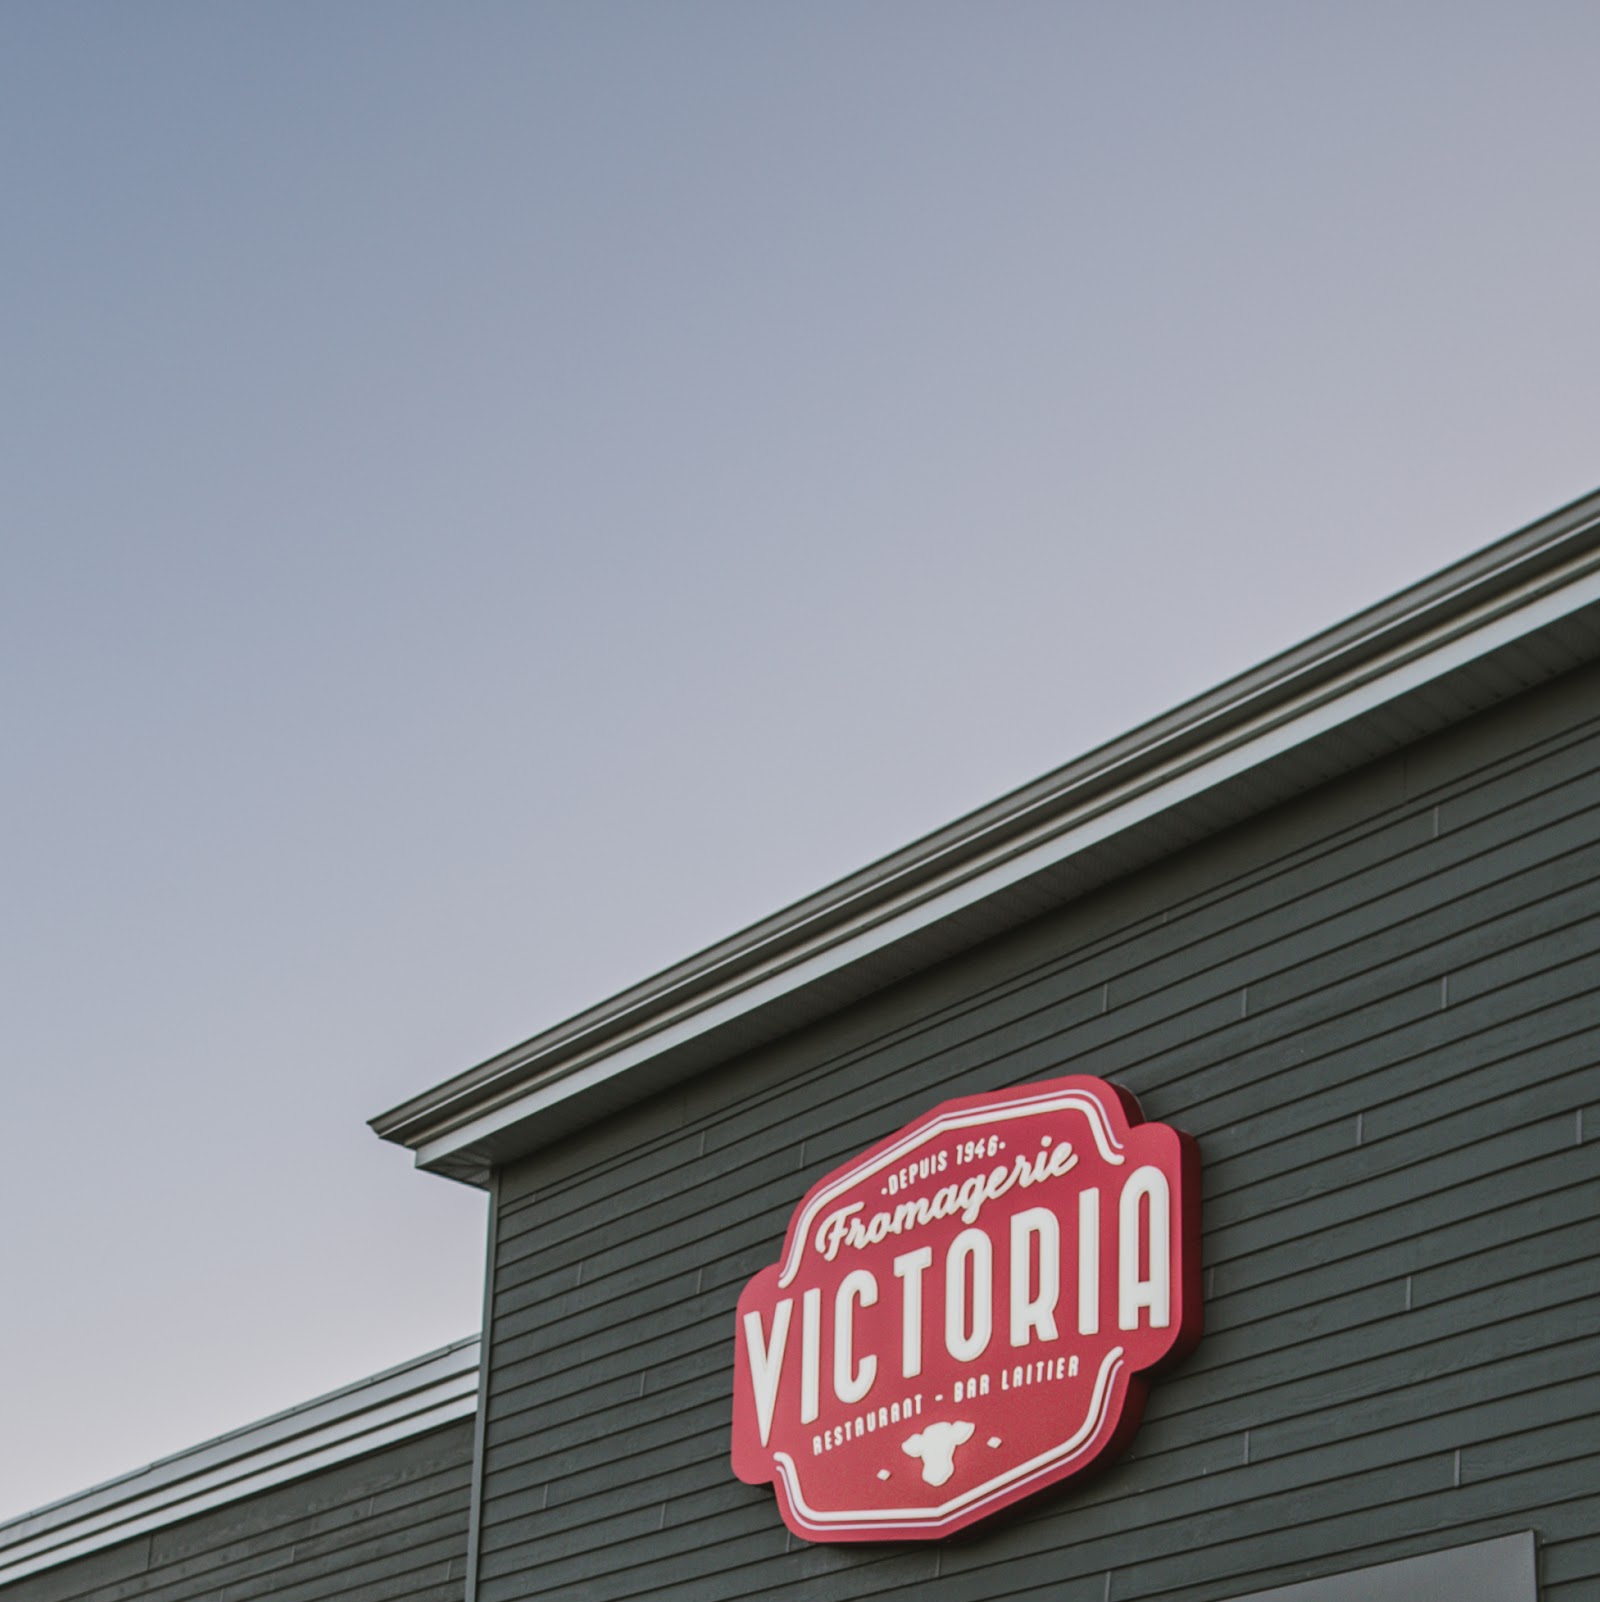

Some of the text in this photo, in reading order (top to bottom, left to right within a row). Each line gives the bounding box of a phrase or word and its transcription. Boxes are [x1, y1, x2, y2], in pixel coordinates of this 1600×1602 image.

[814, 1135, 1079, 1261] Fromagerie
[743, 1165, 1171, 1448] VICTORIA
[812, 1393, 923, 1456] RESTAURANT
[953, 1373, 990, 1403] BAR
[1001, 1354, 1080, 1391] LAITIER
